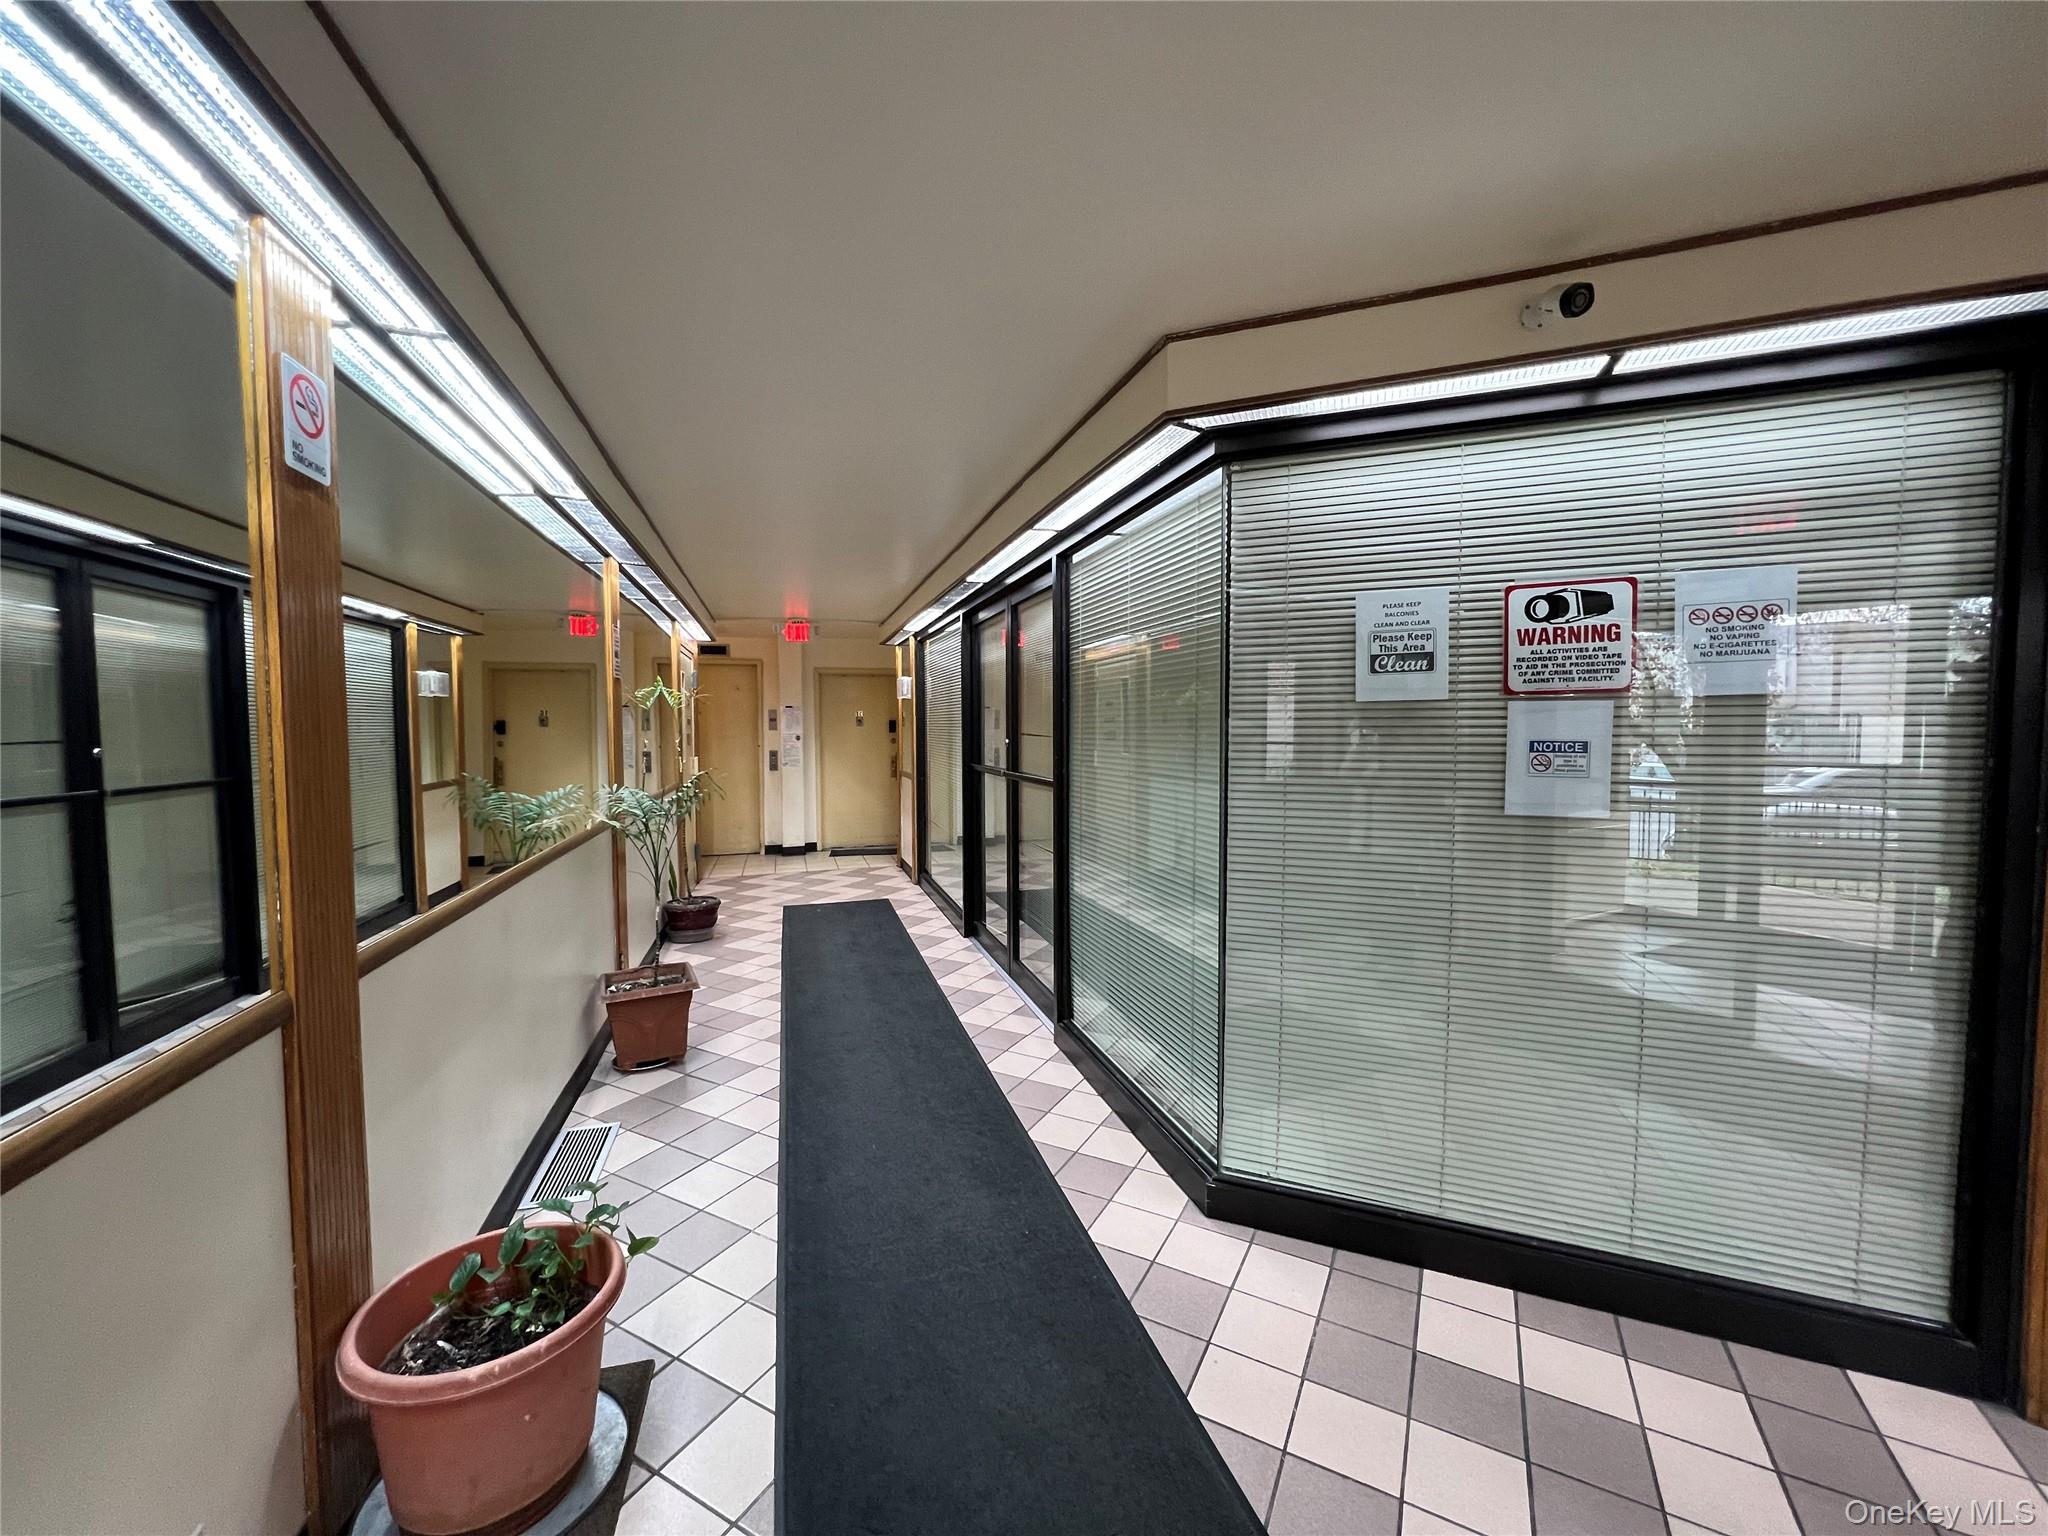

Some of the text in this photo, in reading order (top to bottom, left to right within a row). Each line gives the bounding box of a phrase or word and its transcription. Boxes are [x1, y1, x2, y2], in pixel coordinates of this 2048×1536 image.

[292, 440, 304, 453] NO
[292, 451, 326, 477] SMOKING
[1721, 624, 1765, 632] SMOKING
[1373, 632, 1432, 643] Please Keep
[1516, 623, 1621, 646] WARNING
[1726, 632, 1760, 640] VAPING
[1378, 643, 1425, 653] This Area
[1710, 640, 1776, 648] E-CIGARETTES
[1546, 647, 1590, 655] ACTIVITIES
[1716, 648, 1770, 657] MARIJUANA
[1374, 655, 1430, 672] Clean
[1569, 660, 1626, 668] PROSECUTION
[1576, 667, 1620, 675] COMMITTED
[1534, 742, 1584, 752] NOTICE
